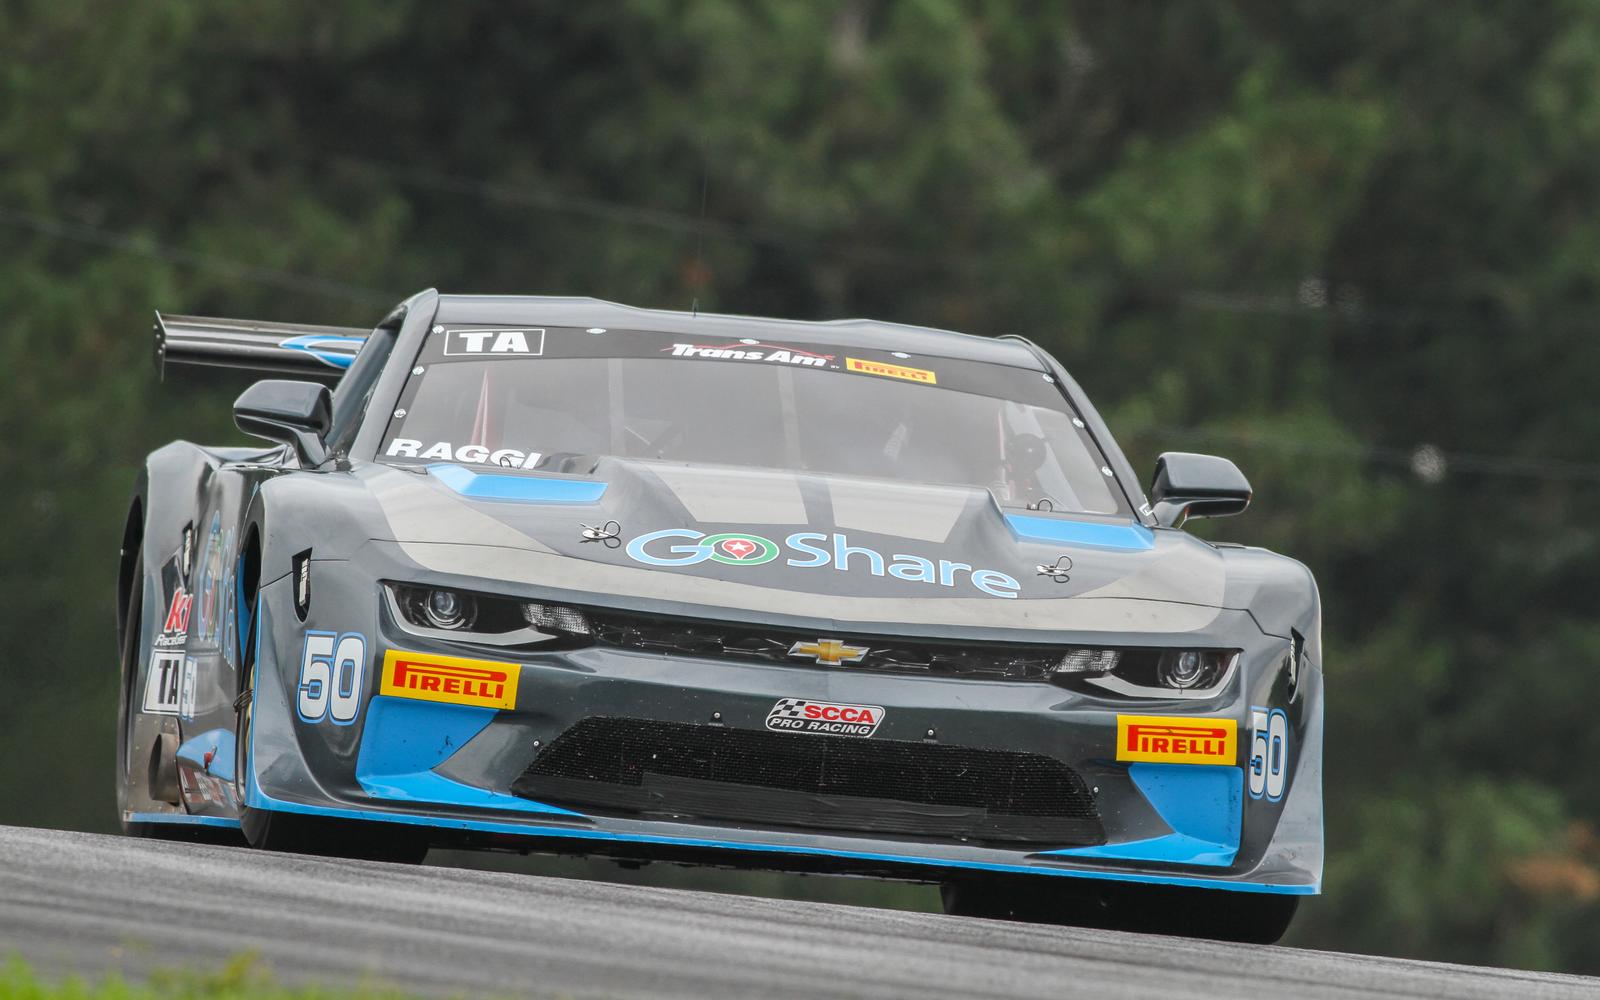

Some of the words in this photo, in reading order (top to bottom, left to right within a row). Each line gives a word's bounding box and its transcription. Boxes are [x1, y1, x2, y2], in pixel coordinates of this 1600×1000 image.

[459, 332, 530, 353] TA
[671, 343, 764, 361] Trans
[764, 351, 827, 367] Am
[854, 361, 928, 380] PIRELLI
[386, 438, 542, 469] RAGGI
[163, 587, 193, 634] K1
[158, 659, 180, 705] TA
[297, 629, 368, 726] 50
[392, 660, 507, 699] PIRELLI
[769, 717, 805, 729] PRO
[807, 722, 872, 735] RACING
[804, 705, 875, 724] SCCA
[1127, 724, 1227, 756] PIRELLI
[1249, 705, 1289, 803] 50
